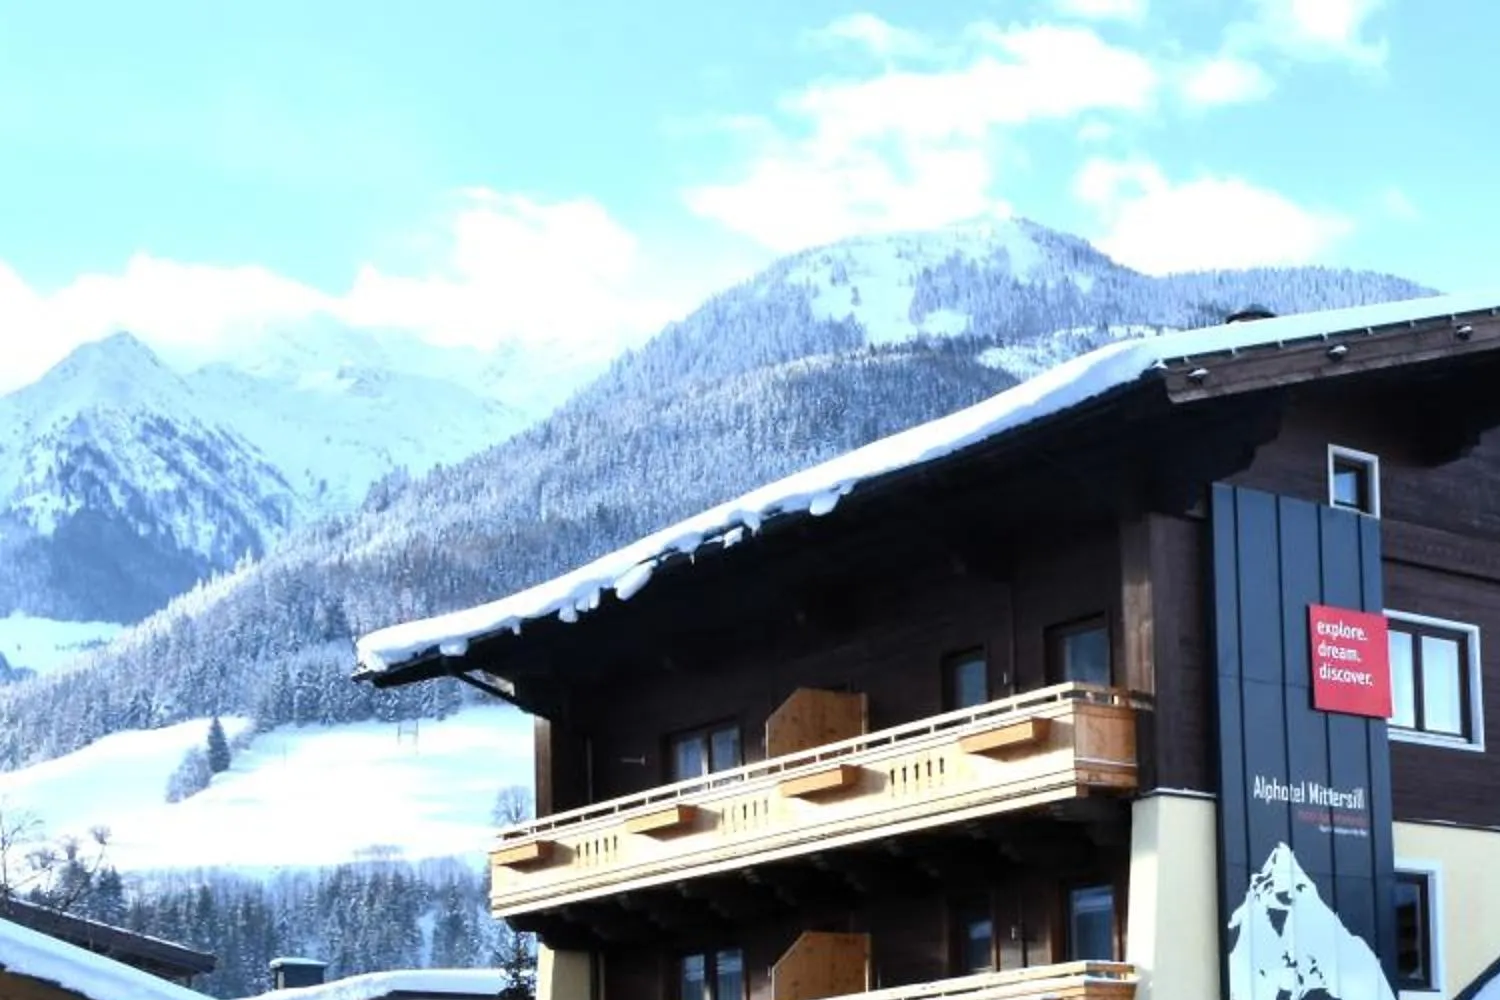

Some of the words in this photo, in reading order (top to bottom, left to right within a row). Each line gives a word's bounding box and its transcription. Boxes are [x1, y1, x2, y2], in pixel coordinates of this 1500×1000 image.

[1317, 620, 1368, 641] explore.
[1318, 640, 1361, 662] dream.
[1319, 662, 1373, 686] discover.
[1254, 775, 1305, 805] Alphotel
[1309, 782, 1365, 809] Mittersill
